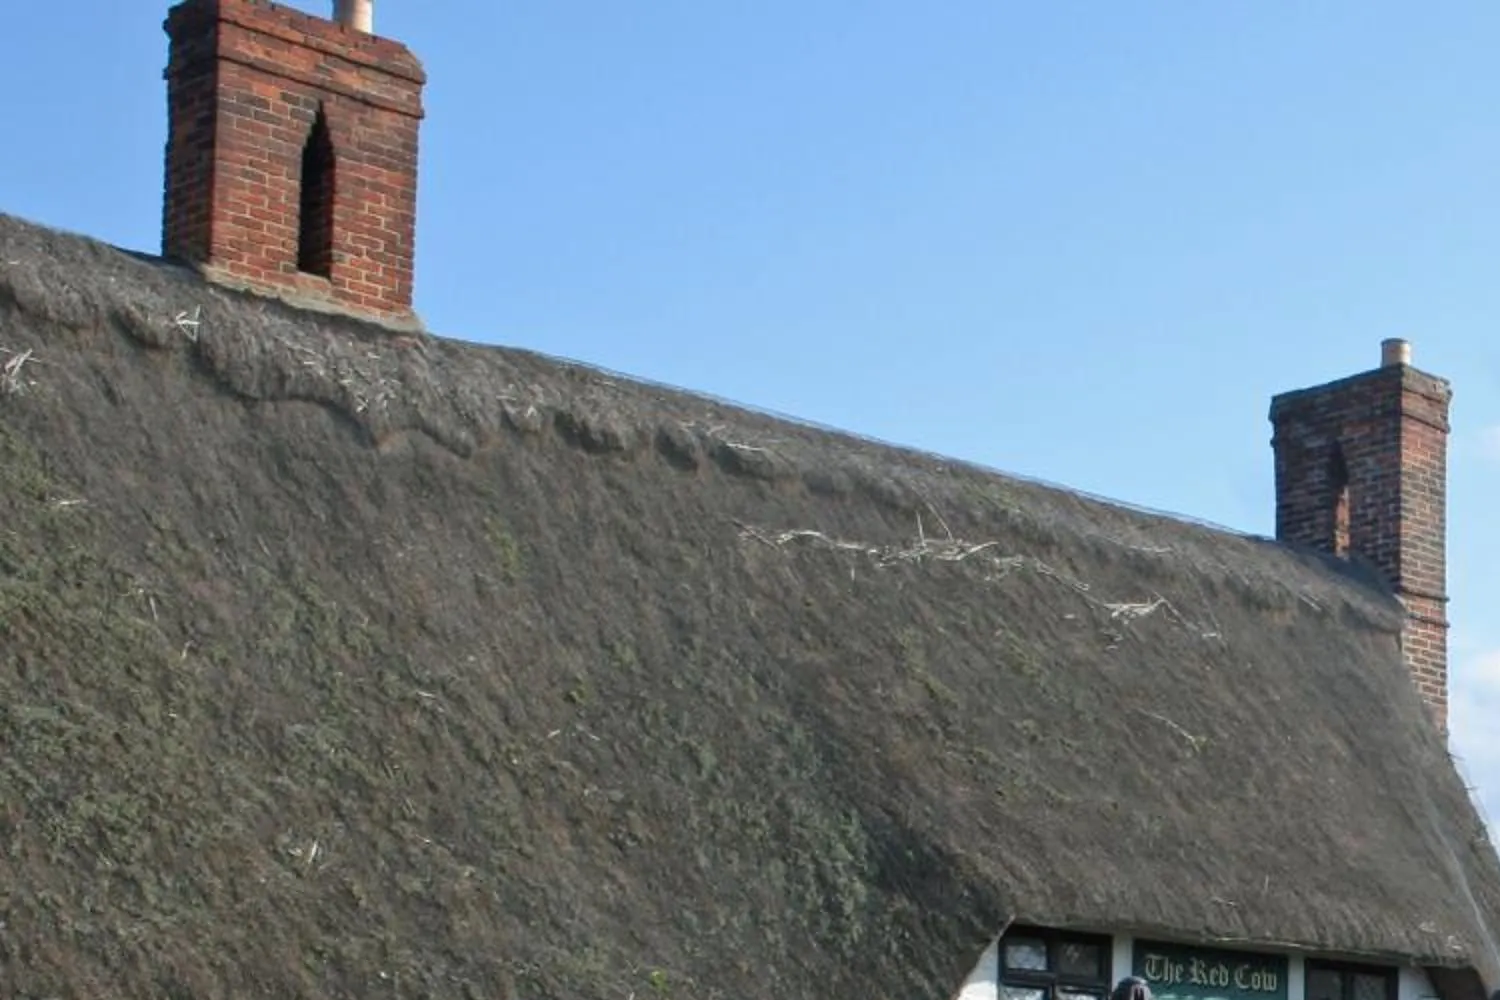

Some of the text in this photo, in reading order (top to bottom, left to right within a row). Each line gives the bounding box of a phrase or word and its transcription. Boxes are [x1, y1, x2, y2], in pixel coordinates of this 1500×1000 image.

[1145, 954, 1277, 991] The Red Cow
